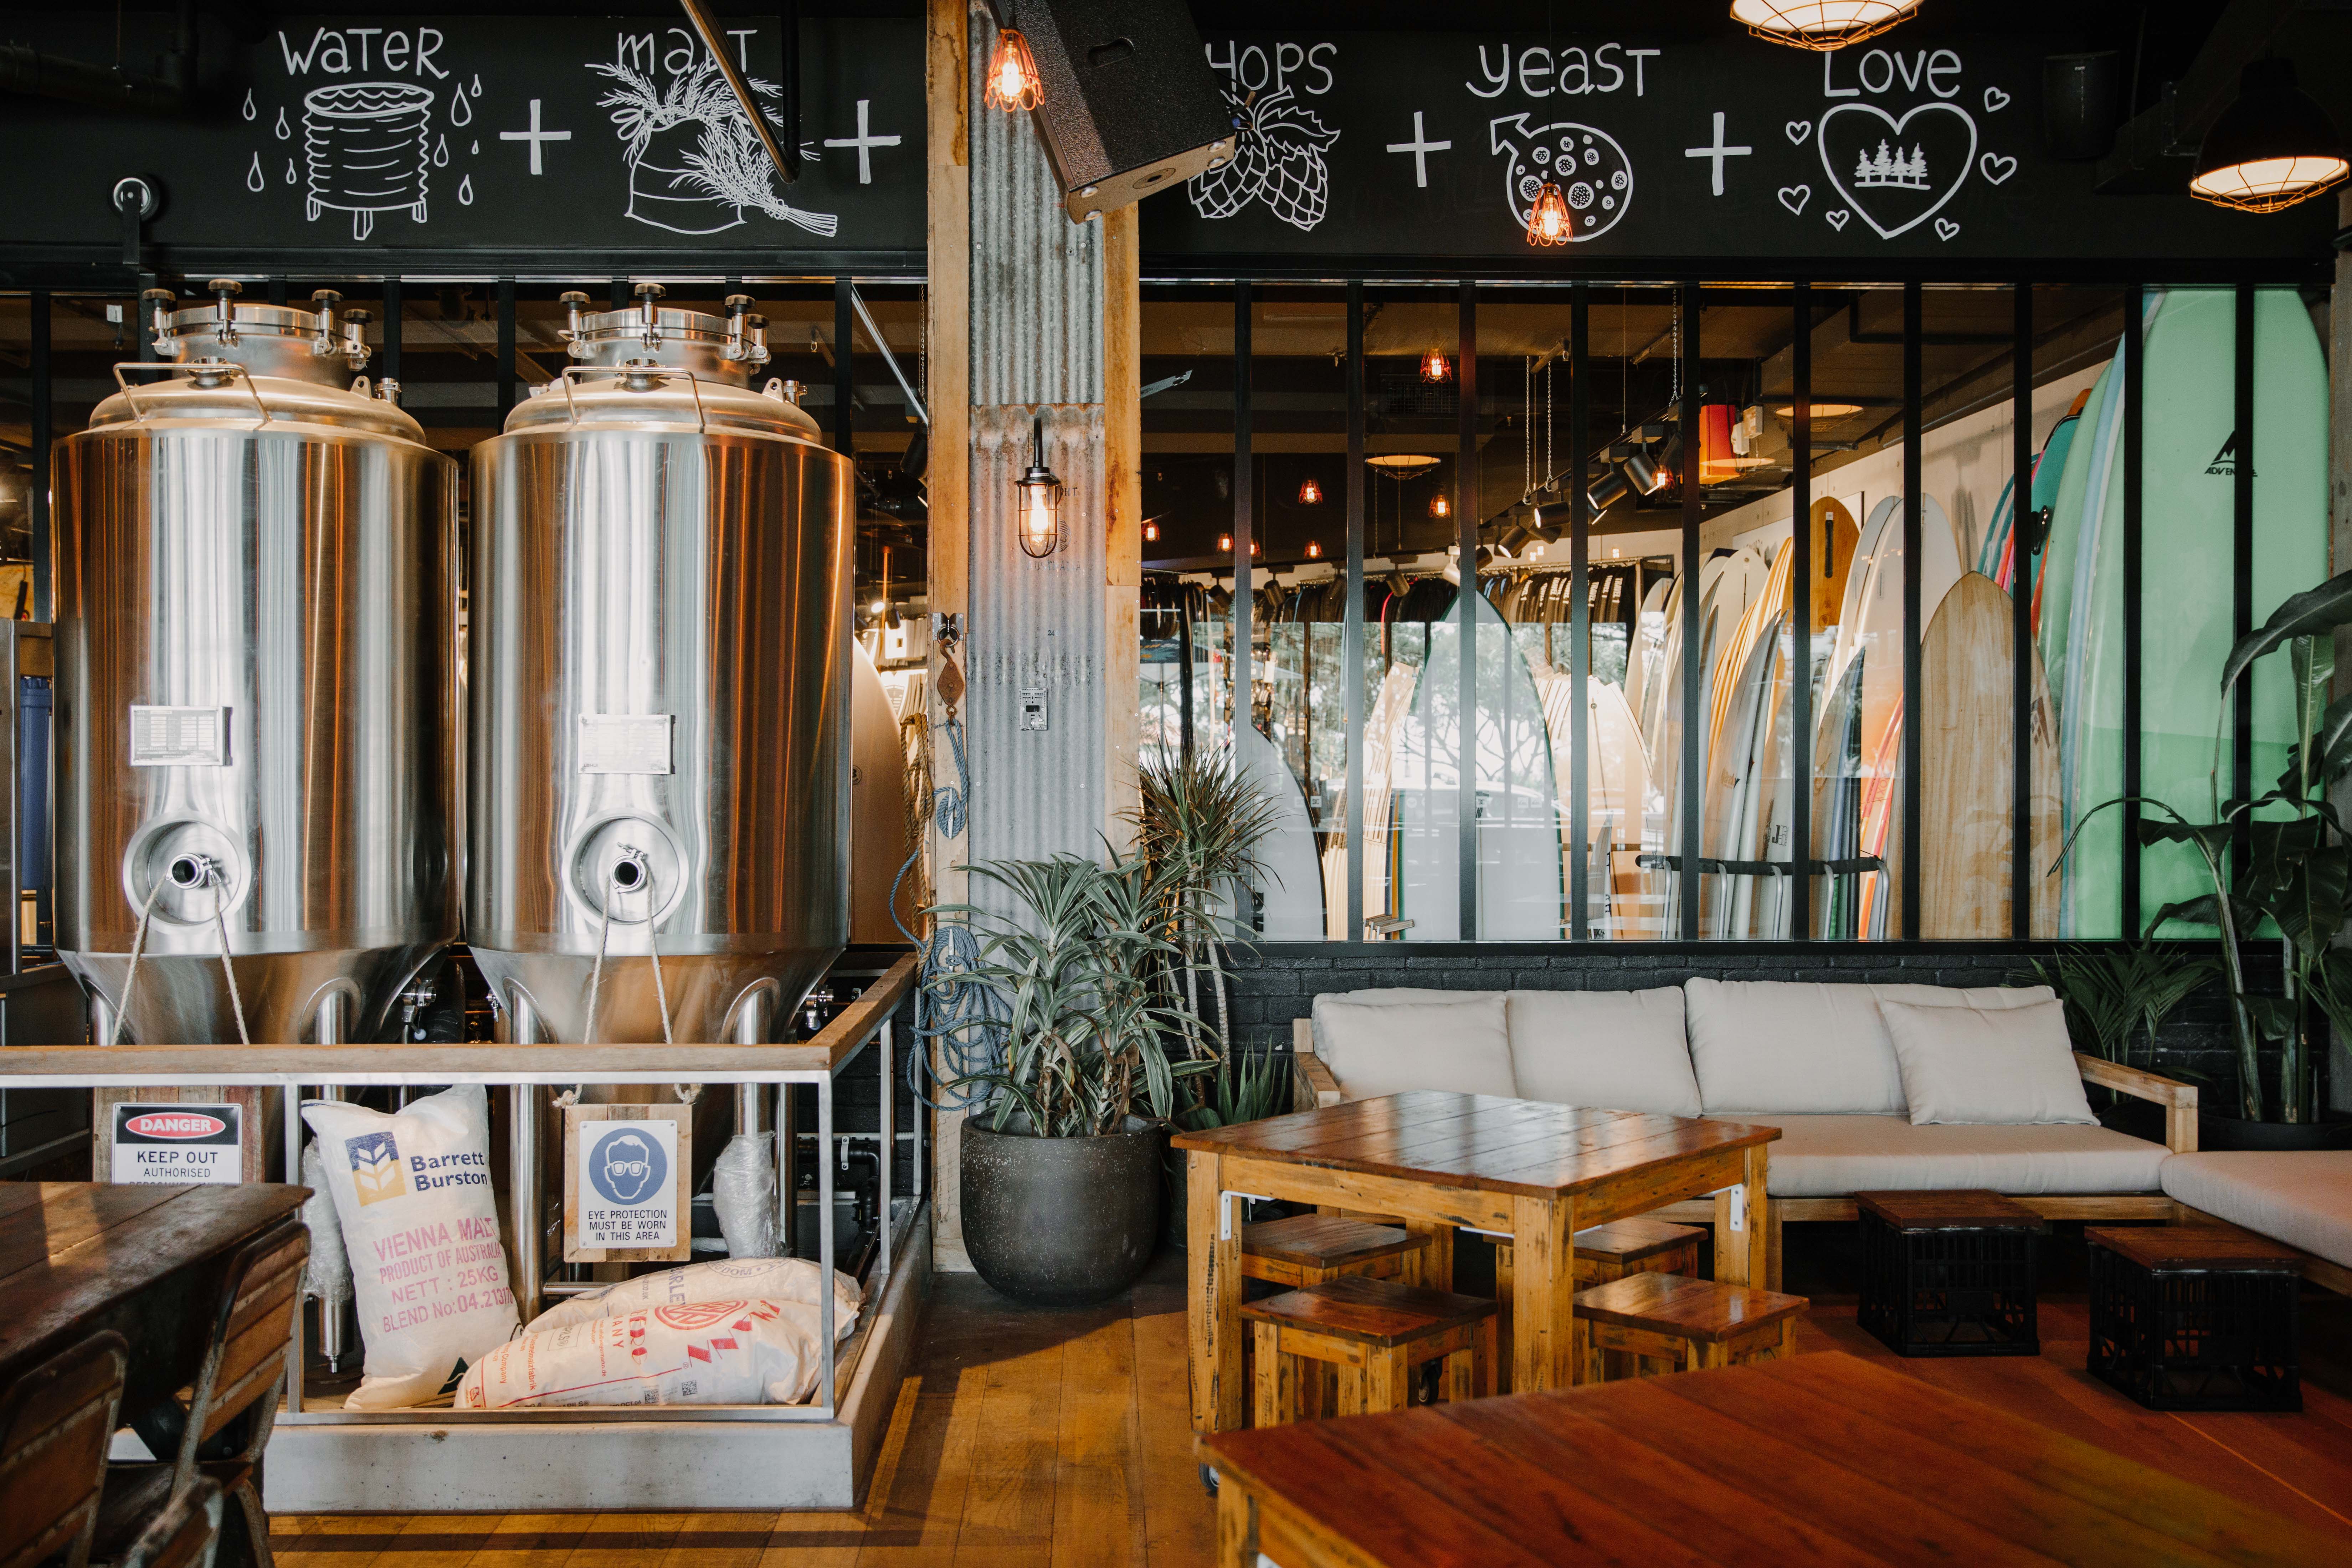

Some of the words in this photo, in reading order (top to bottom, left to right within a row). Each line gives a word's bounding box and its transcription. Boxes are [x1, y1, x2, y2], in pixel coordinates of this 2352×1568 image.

[1205, 40, 1337, 94] HOPS
[140, 1118, 212, 1132] DANGER
[138, 1151, 179, 1163] KEEP
[186, 1151, 219, 1163] OUT
[410, 1151, 484, 1172] Barrett
[144, 1168, 211, 1178] AUTHORISED
[414, 1171, 488, 1192] Burston
[588, 1210, 605, 1219] EYE
[610, 1210, 667, 1219] PROTECTION
[589, 1221, 616, 1230] MUST
[621, 1221, 632, 1229] BE
[637, 1221, 666, 1229] WORN
[373, 1222, 453, 1261] VIENNA
[457, 1217, 497, 1241] MALT
[596, 1232, 605, 1241] IN
[610, 1232, 630, 1240] THIS
[636, 1232, 659, 1240] AREA
[379, 1253, 433, 1284] PRODUCT
[437, 1249, 451, 1268] OF
[456, 1242, 502, 1264] AUSTRALIA
[391, 1277, 440, 1305] NETT
[457, 1265, 499, 1288] 25KG
[382, 1305, 429, 1333] BLEND
[500, 1354, 509, 1383] Company
